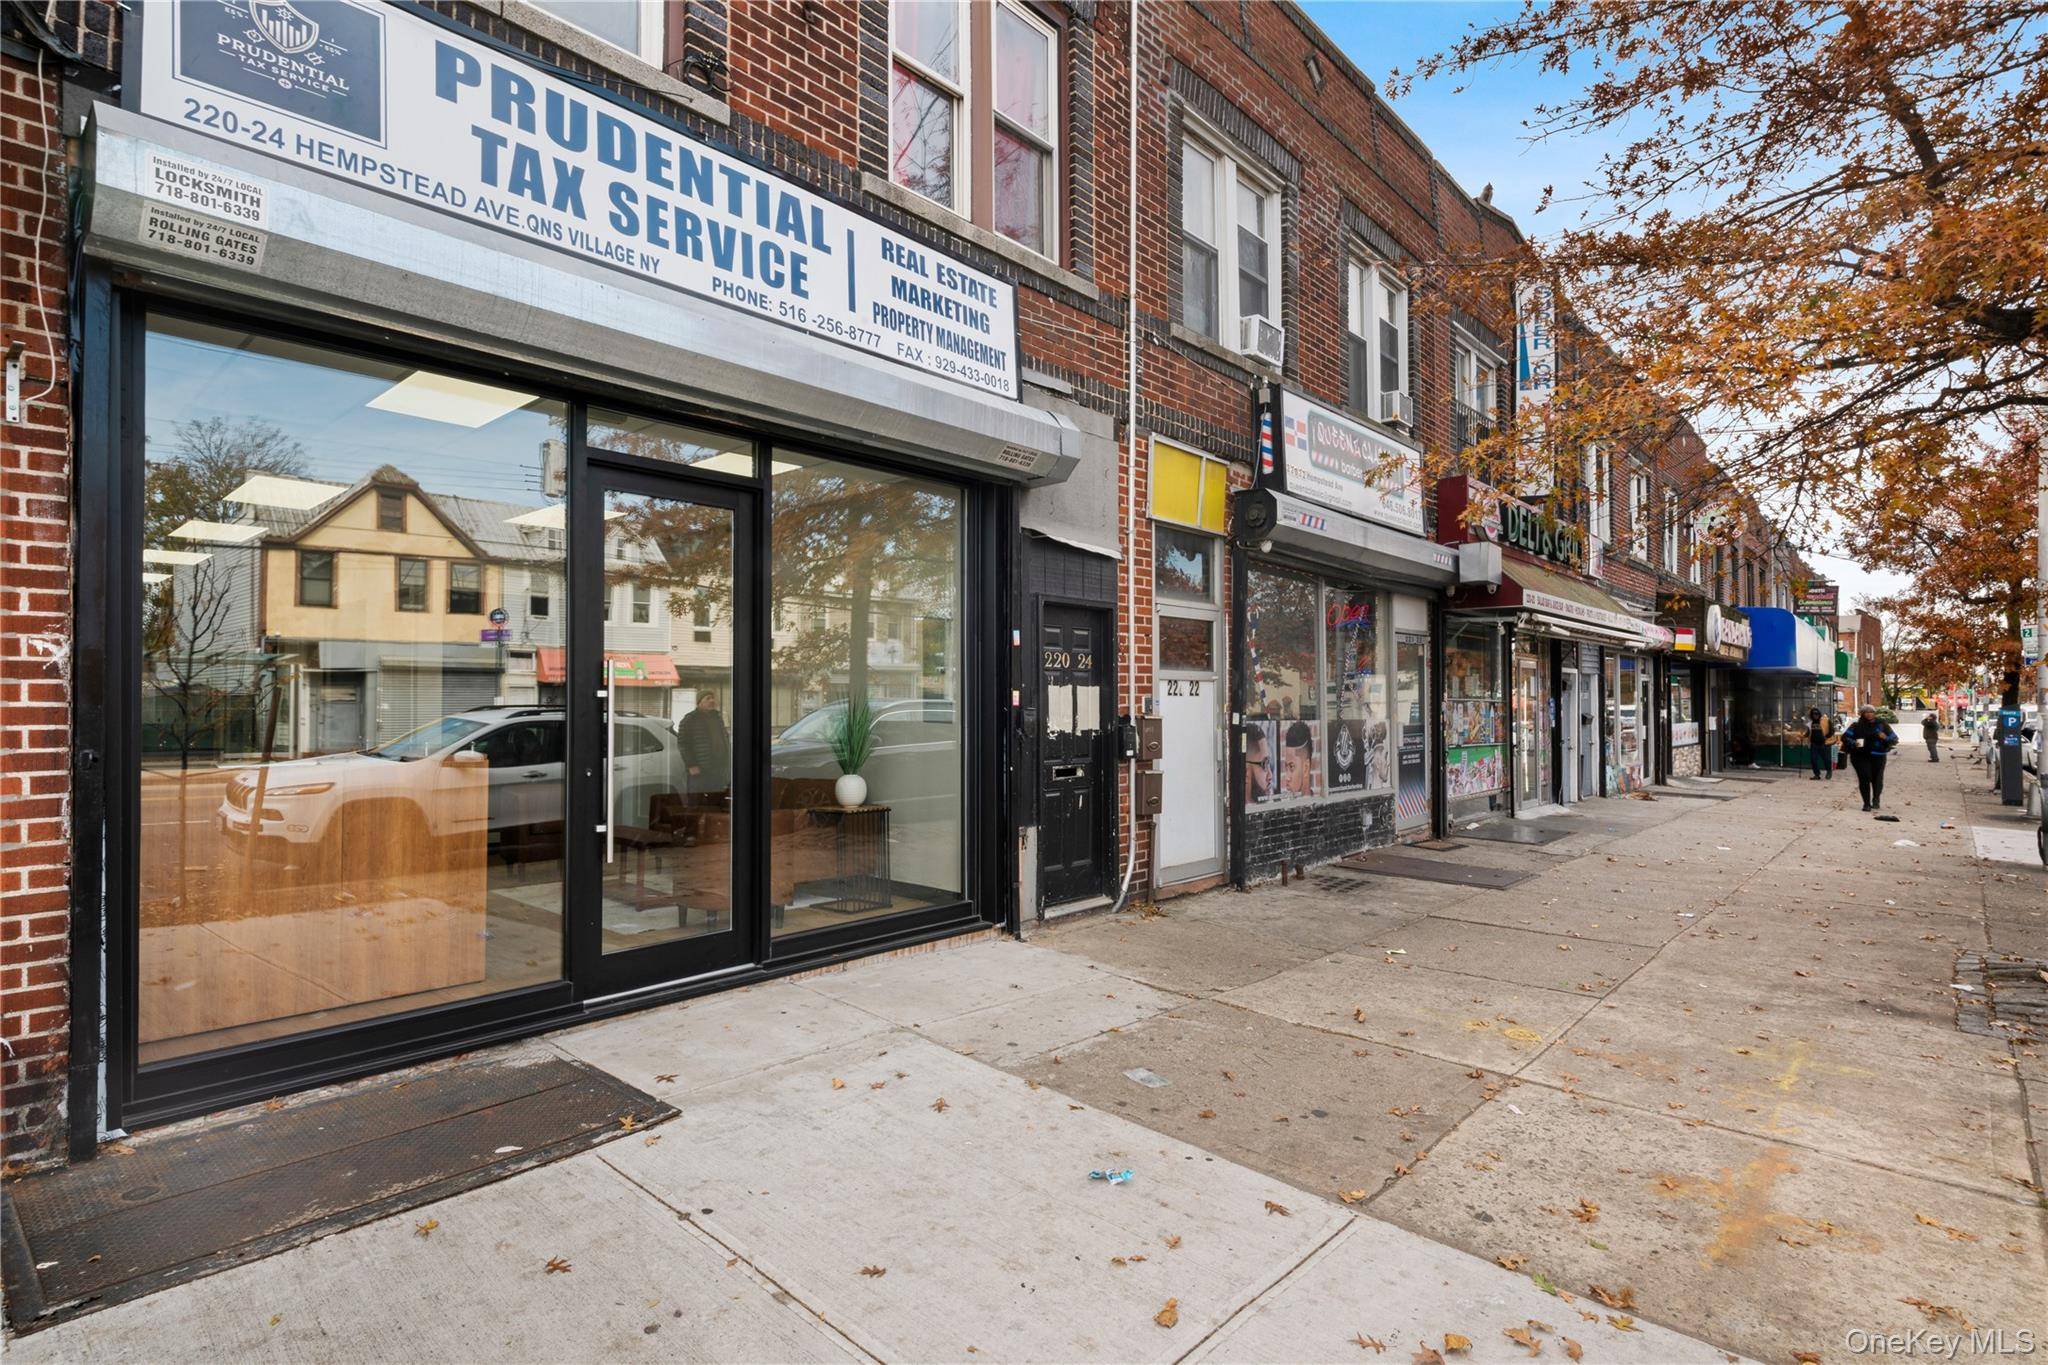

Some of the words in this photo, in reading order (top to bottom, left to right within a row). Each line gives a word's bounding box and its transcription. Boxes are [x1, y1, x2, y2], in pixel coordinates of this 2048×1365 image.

[217, 33, 350, 90] PRUDENTIAL
[239, 55, 266, 70] TAX
[272, 66, 330, 92] SERVICE
[435, 40, 831, 255] PRUDENTIAL
[153, 156, 195, 175] Installed
[198, 171, 209, 180] by
[212, 174, 233, 186] 24/7
[236, 183, 263, 196] LOCAL
[155, 167, 261, 208] LOCKSMITH
[184, 97, 285, 149] 220-24
[296, 134, 467, 208] HEMPSTEAD
[568, 229, 635, 265] VILLAGE
[640, 253, 661, 274] NY
[155, 182, 260, 221] 718-801-6339
[471, 124, 587, 220] TAX
[608, 181, 809, 299] SERVICE
[149, 217, 210, 241] ROLLING
[216, 236, 258, 254] GATES
[151, 207, 191, 224] Installed
[193, 219, 204, 228] by
[207, 223, 227, 233] 24/7
[230, 228, 260, 243] LOCAL
[148, 229, 254, 266] 718-801-6339
[881, 236, 928, 278] REAL
[937, 263, 998, 308] ESTATE
[712, 276, 773, 312] PHONE:
[891, 276, 990, 335] MARKETING
[873, 301, 932, 344] PROPERTY
[936, 326, 1006, 372] MANAGEMENT
[935, 355, 1010, 392] 929-433-0018
[1044, 652, 1070, 668] 220
[1078, 654, 1092, 669] 24
[1189, 680, 1200, 696] 22
